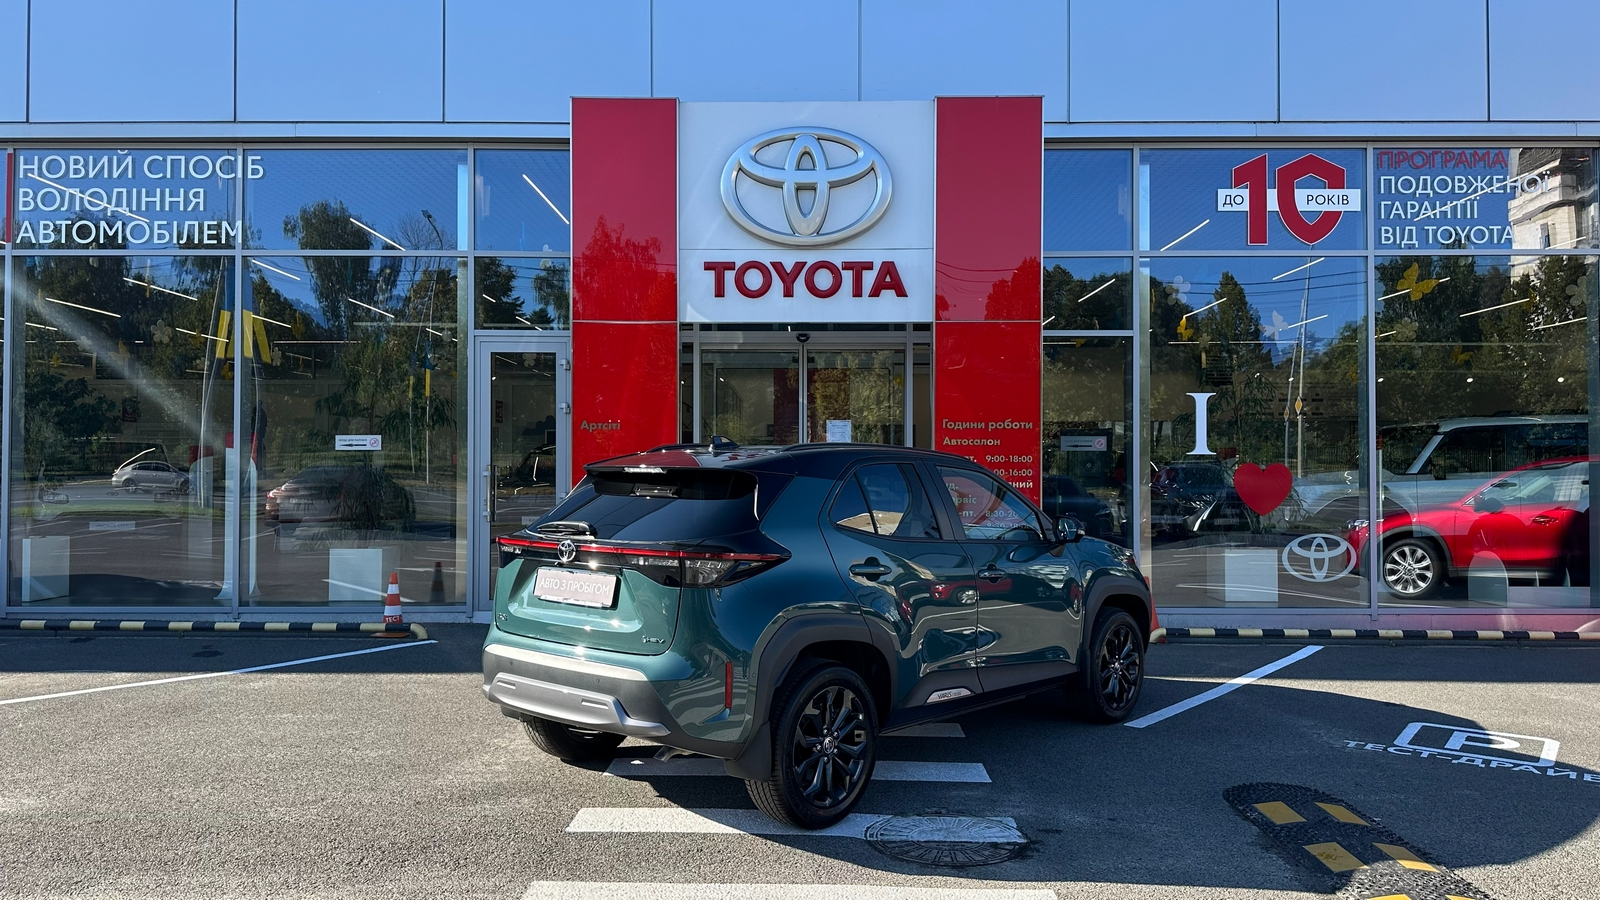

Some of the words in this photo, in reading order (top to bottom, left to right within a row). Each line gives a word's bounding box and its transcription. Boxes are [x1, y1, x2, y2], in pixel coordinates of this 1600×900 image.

[18, 150, 134, 179] НОВИЙ
[143, 154, 265, 179] СПОСІБ
[1378, 149, 1508, 169] ПРОГРАМА
[1380, 170, 1551, 198] ПОДОВЖЕНОЇ
[18, 187, 205, 216] ВОЛОДІННЯ
[1222, 194, 1245, 207] ДО
[1232, 153, 1347, 246] 10
[1306, 194, 1350, 207] РОКІВ
[1380, 196, 1479, 219] ГАРАНТІЇ
[16, 220, 243, 245] АВТОМОБІЛЕМ
[1380, 226, 1419, 248] ВІД
[1423, 226, 1513, 245] TOYOTA
[703, 260, 909, 299] TOYOTA
[580, 419, 621, 433] Артсіті
[942, 419, 985, 430] Години
[988, 419, 1033, 432] роботи
[1186, 392, 1217, 455] I
[943, 436, 1001, 446] Автосалон
[985, 455, 1033, 463] 9:00-18:00
[993, 468, 1033, 477] 00-16:00
[539, 577, 560, 590] АВТО
[567, 580, 611, 595] ПРОБІГОМ
[1344, 739, 1600, 783] ТЕСТ-ДРАЙВ
